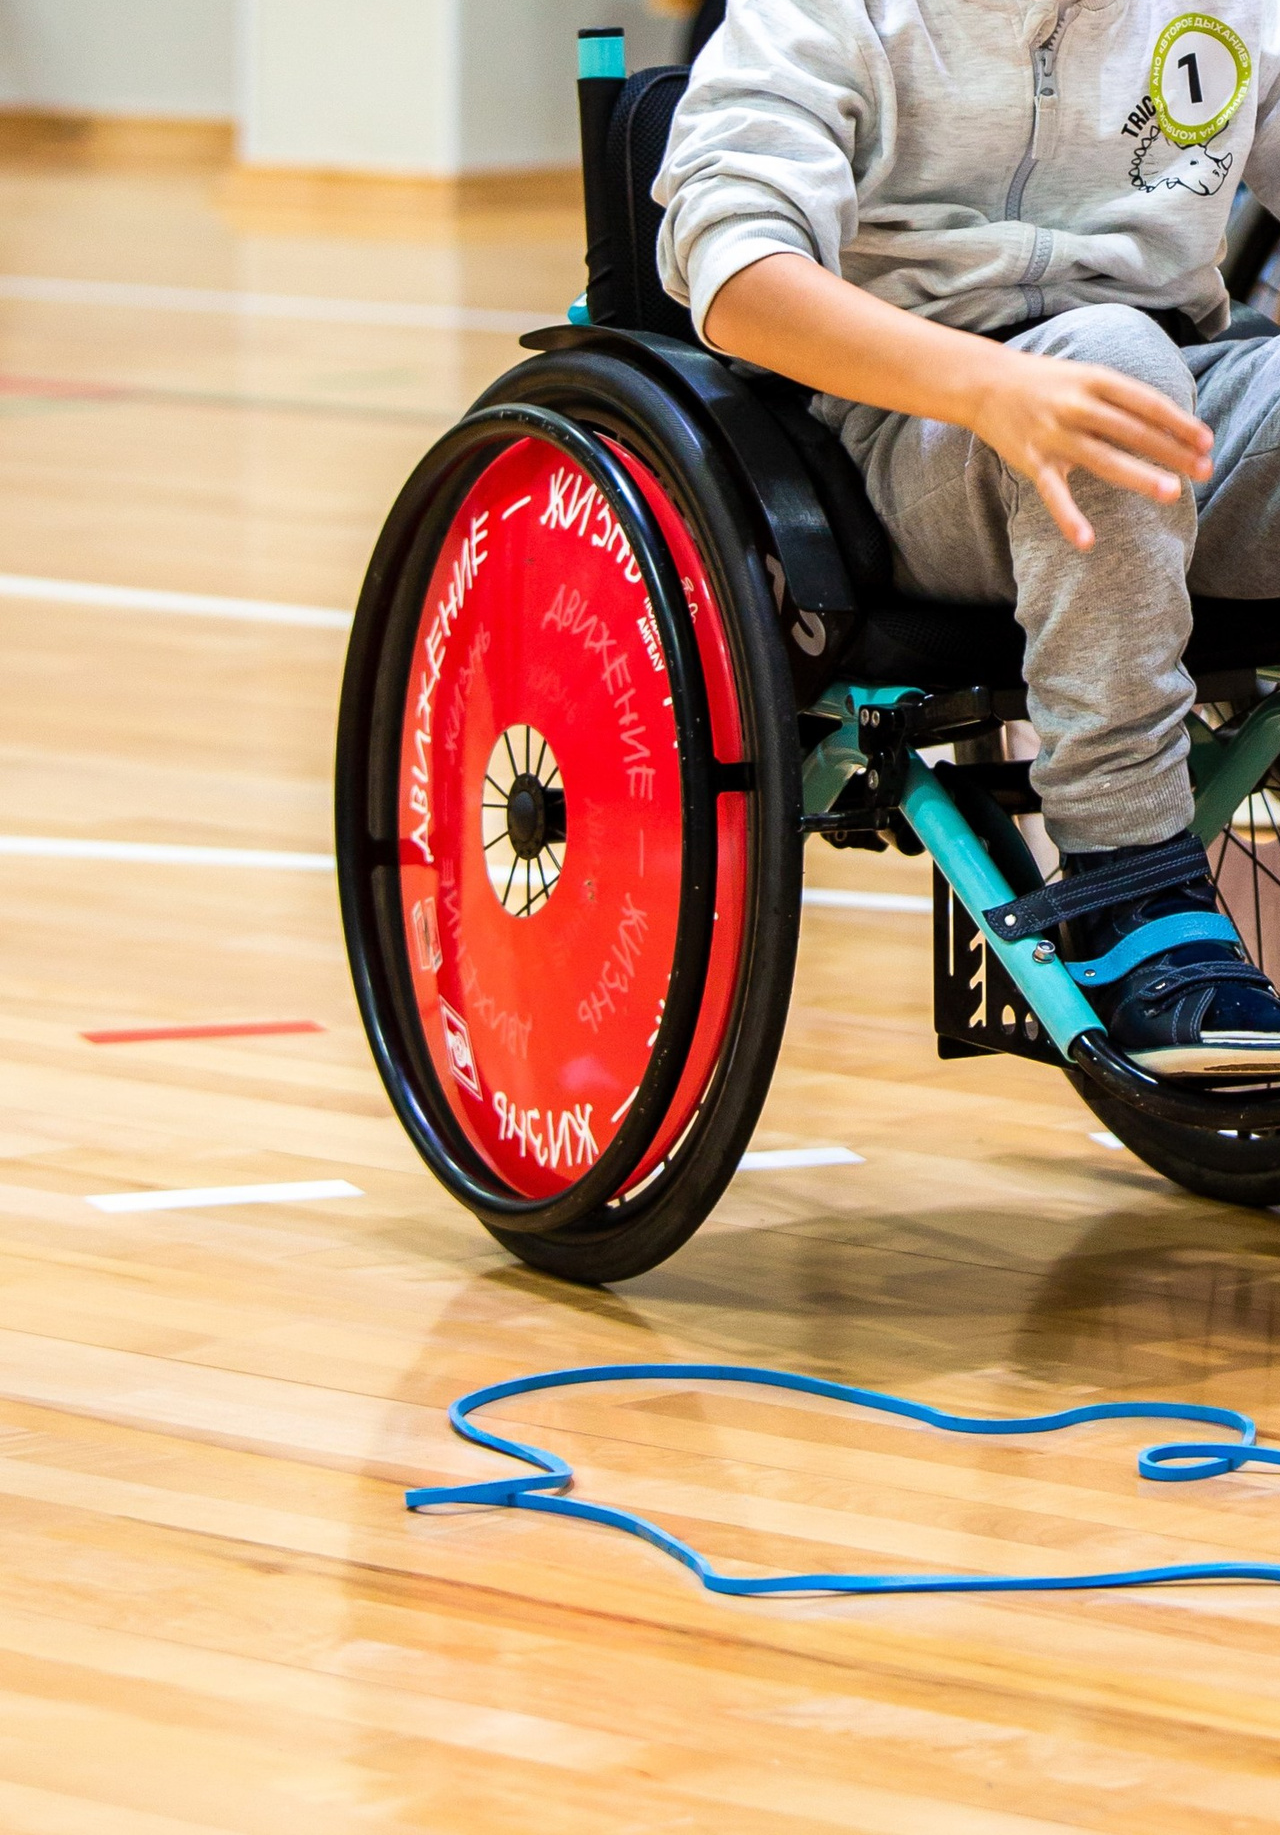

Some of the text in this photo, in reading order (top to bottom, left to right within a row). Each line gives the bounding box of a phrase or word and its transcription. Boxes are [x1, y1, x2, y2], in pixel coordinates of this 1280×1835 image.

[1159, 17, 1193, 54] «ВТОРОЕ
[1194, 17, 1249, 68] ДЫХАНИЕ»
[1153, 56, 1162, 86] АНО
[1177, 53, 1203, 104] 1
[1200, 124, 1215, 138] НА
[409, 510, 489, 864] ДВИЖЕНИЕ
[541, 583, 656, 801] ДВИЖЕНИЕ
[578, 892, 648, 1034] ЖИЗНЬ
[493, 1090, 599, 1169] ЖИЗНЬ
